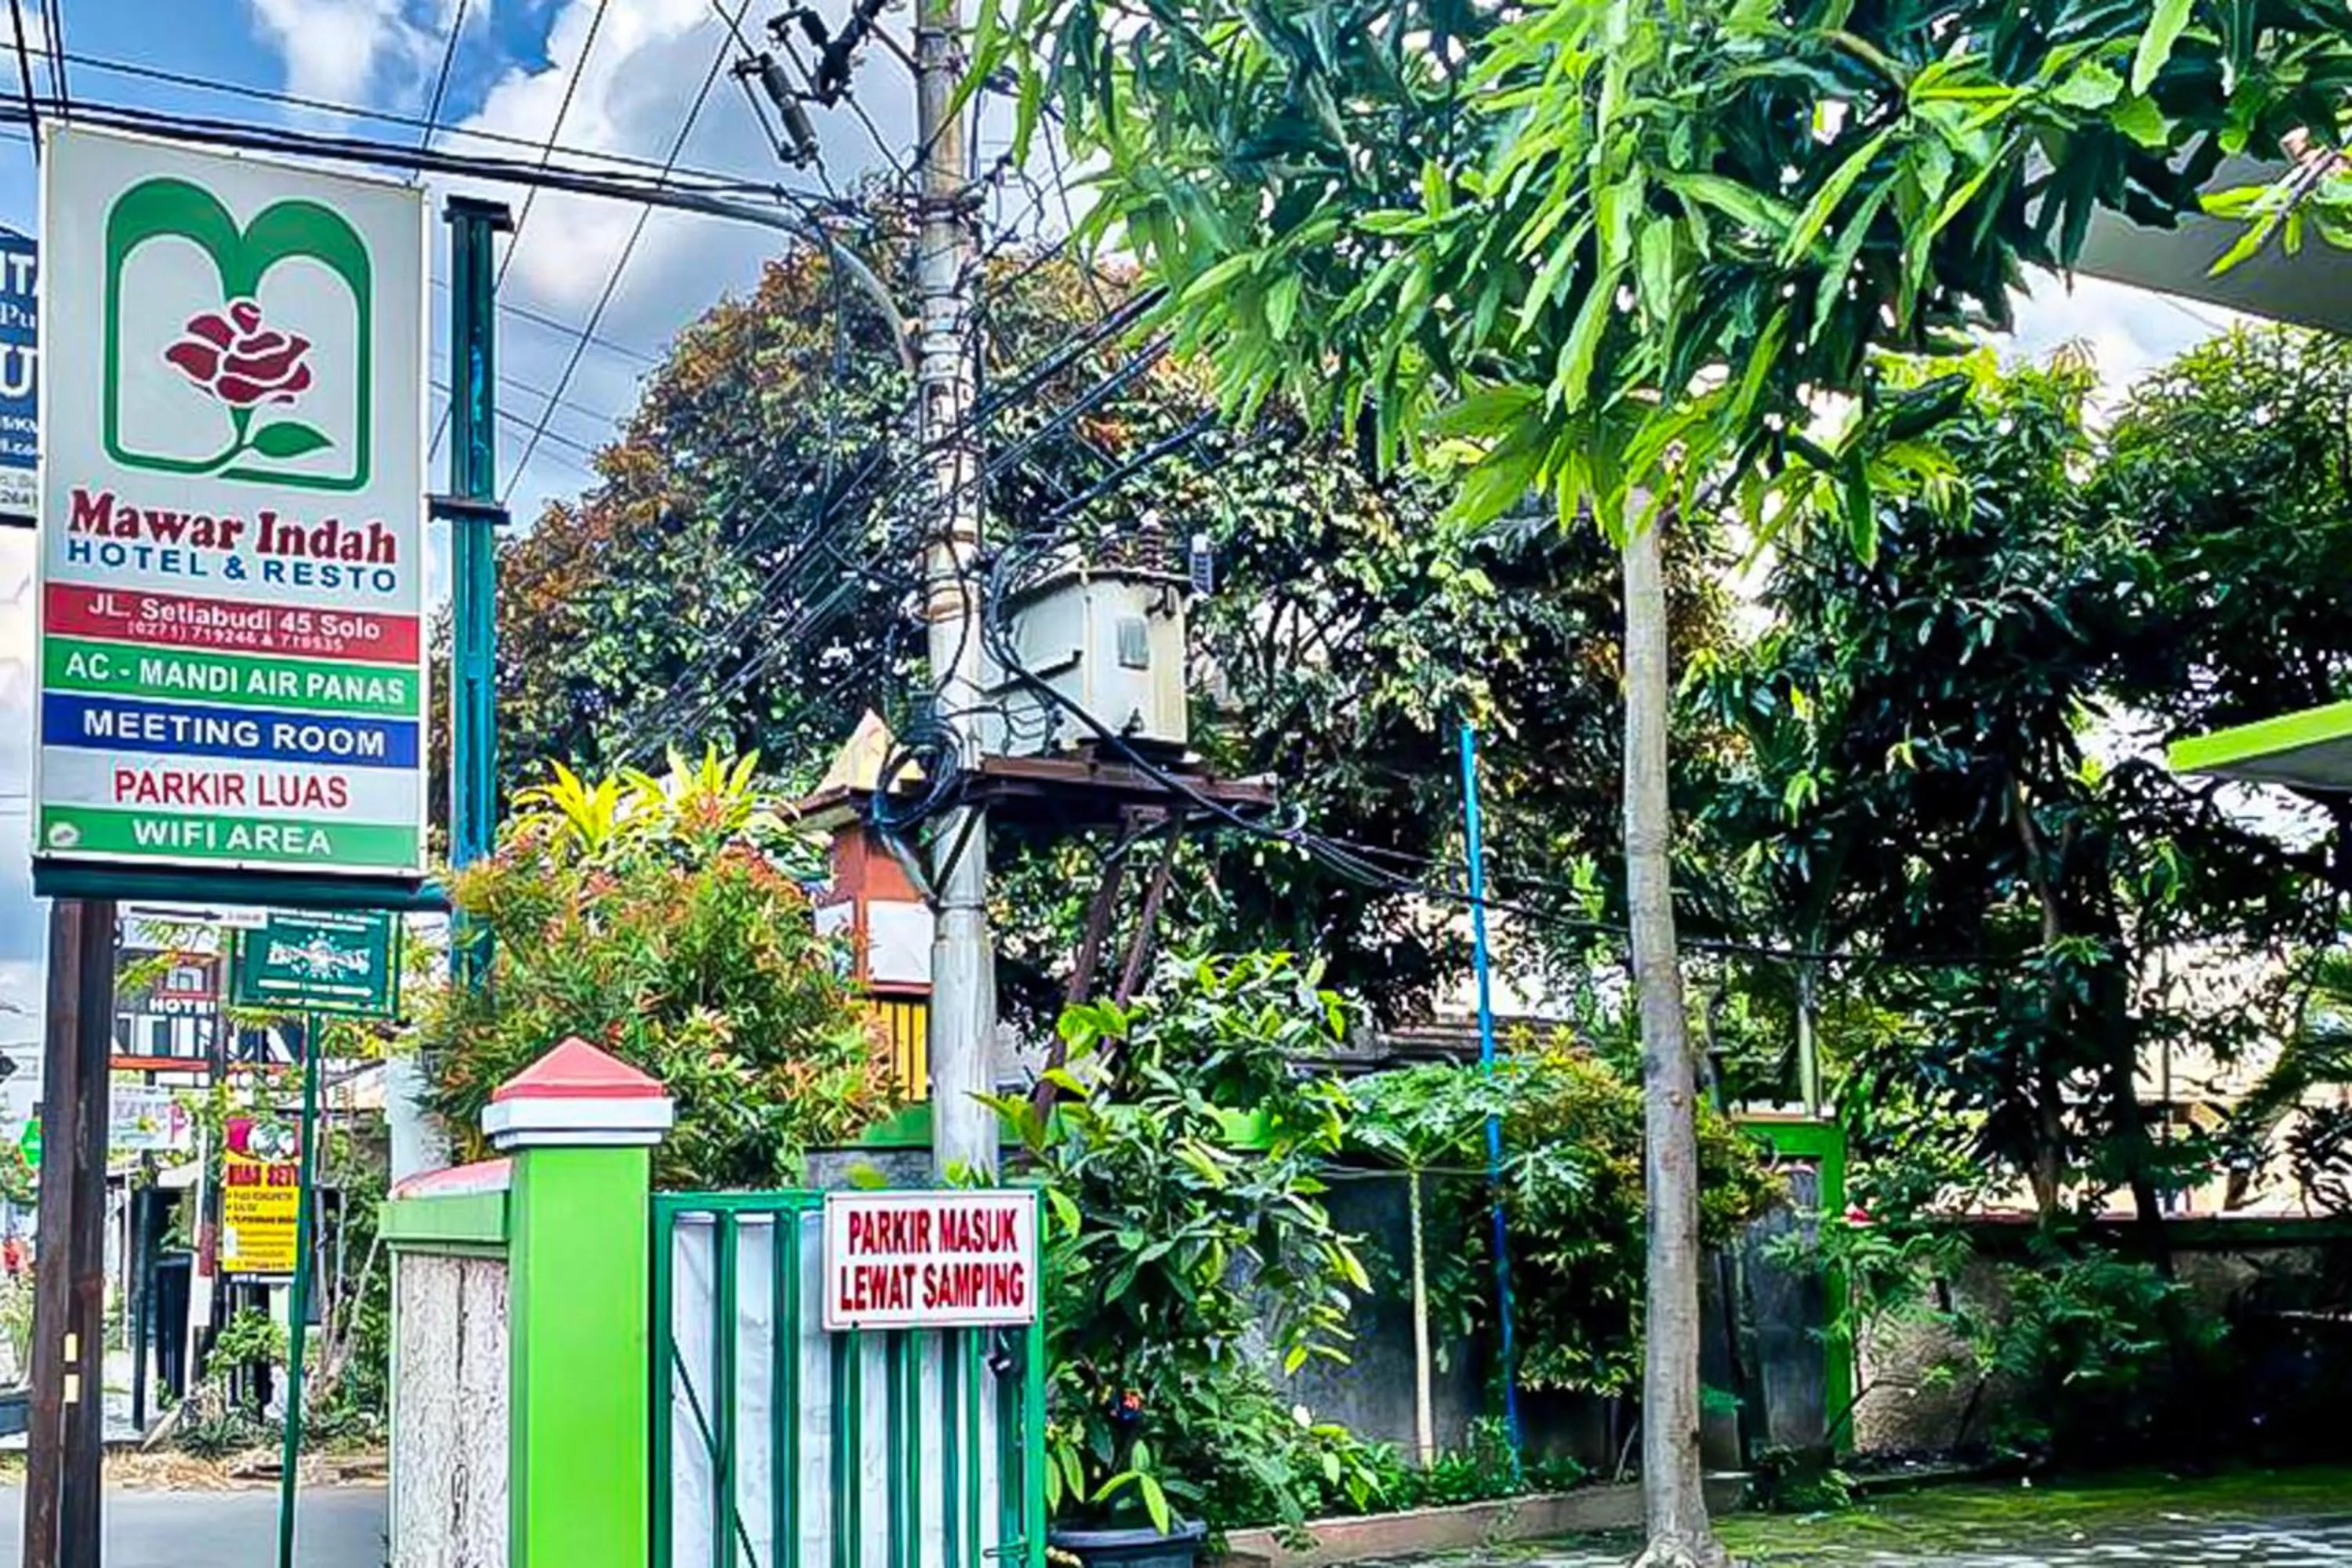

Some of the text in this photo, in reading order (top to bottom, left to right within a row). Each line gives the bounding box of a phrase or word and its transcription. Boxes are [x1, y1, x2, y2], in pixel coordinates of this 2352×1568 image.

[68, 488, 396, 564] Mawar Indah
[68, 539, 396, 592] HOTEL & RESTO
[140, 597, 271, 632] Setiabudi
[280, 612, 313, 633] 45
[320, 614, 381, 640] Solo
[65, 652, 110, 680] AC
[140, 658, 238, 692] MANDI
[247, 669, 299, 697] AIR
[307, 673, 405, 704] PANAS
[84, 709, 385, 757] MEETING ROOM
[114, 770, 347, 808] PARKIR LUAS
[133, 819, 332, 855] WIFI AREA
[849, 1208, 1018, 1254] PARKIR MASUK
[840, 1261, 1024, 1311] LEWAT SAMPING
